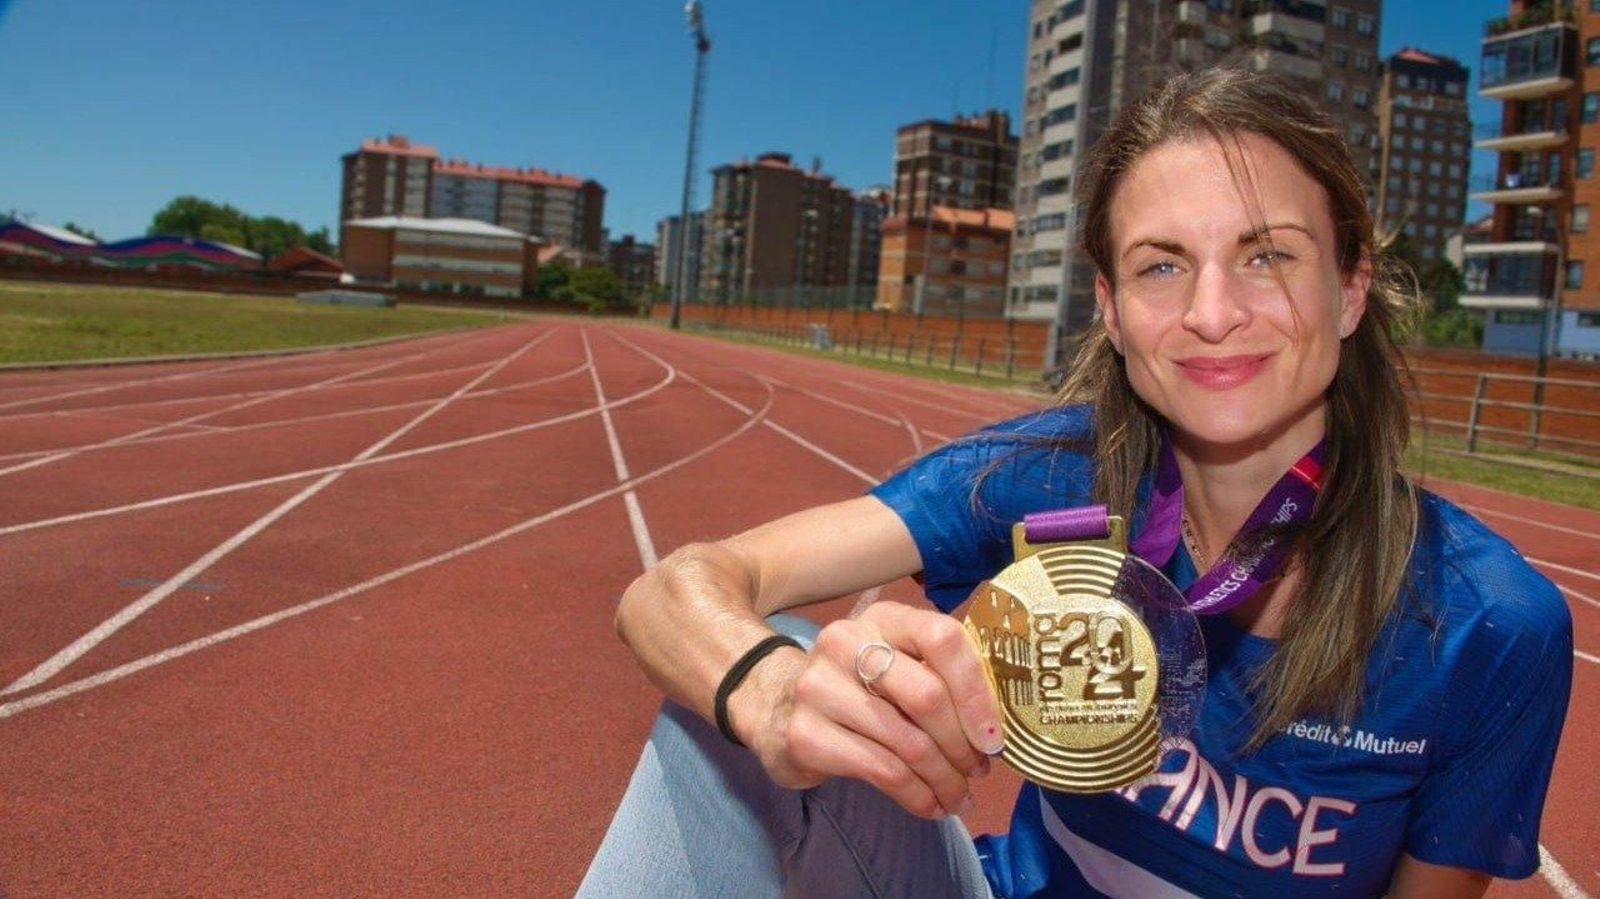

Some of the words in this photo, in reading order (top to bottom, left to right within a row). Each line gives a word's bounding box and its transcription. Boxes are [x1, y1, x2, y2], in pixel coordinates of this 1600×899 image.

[1040, 713, 1138, 725] CHAMPIONSHIPS
[1278, 719, 1332, 744] rédit
[1353, 730, 1427, 754] Mutuel
[1113, 736, 1357, 876] ANCE
